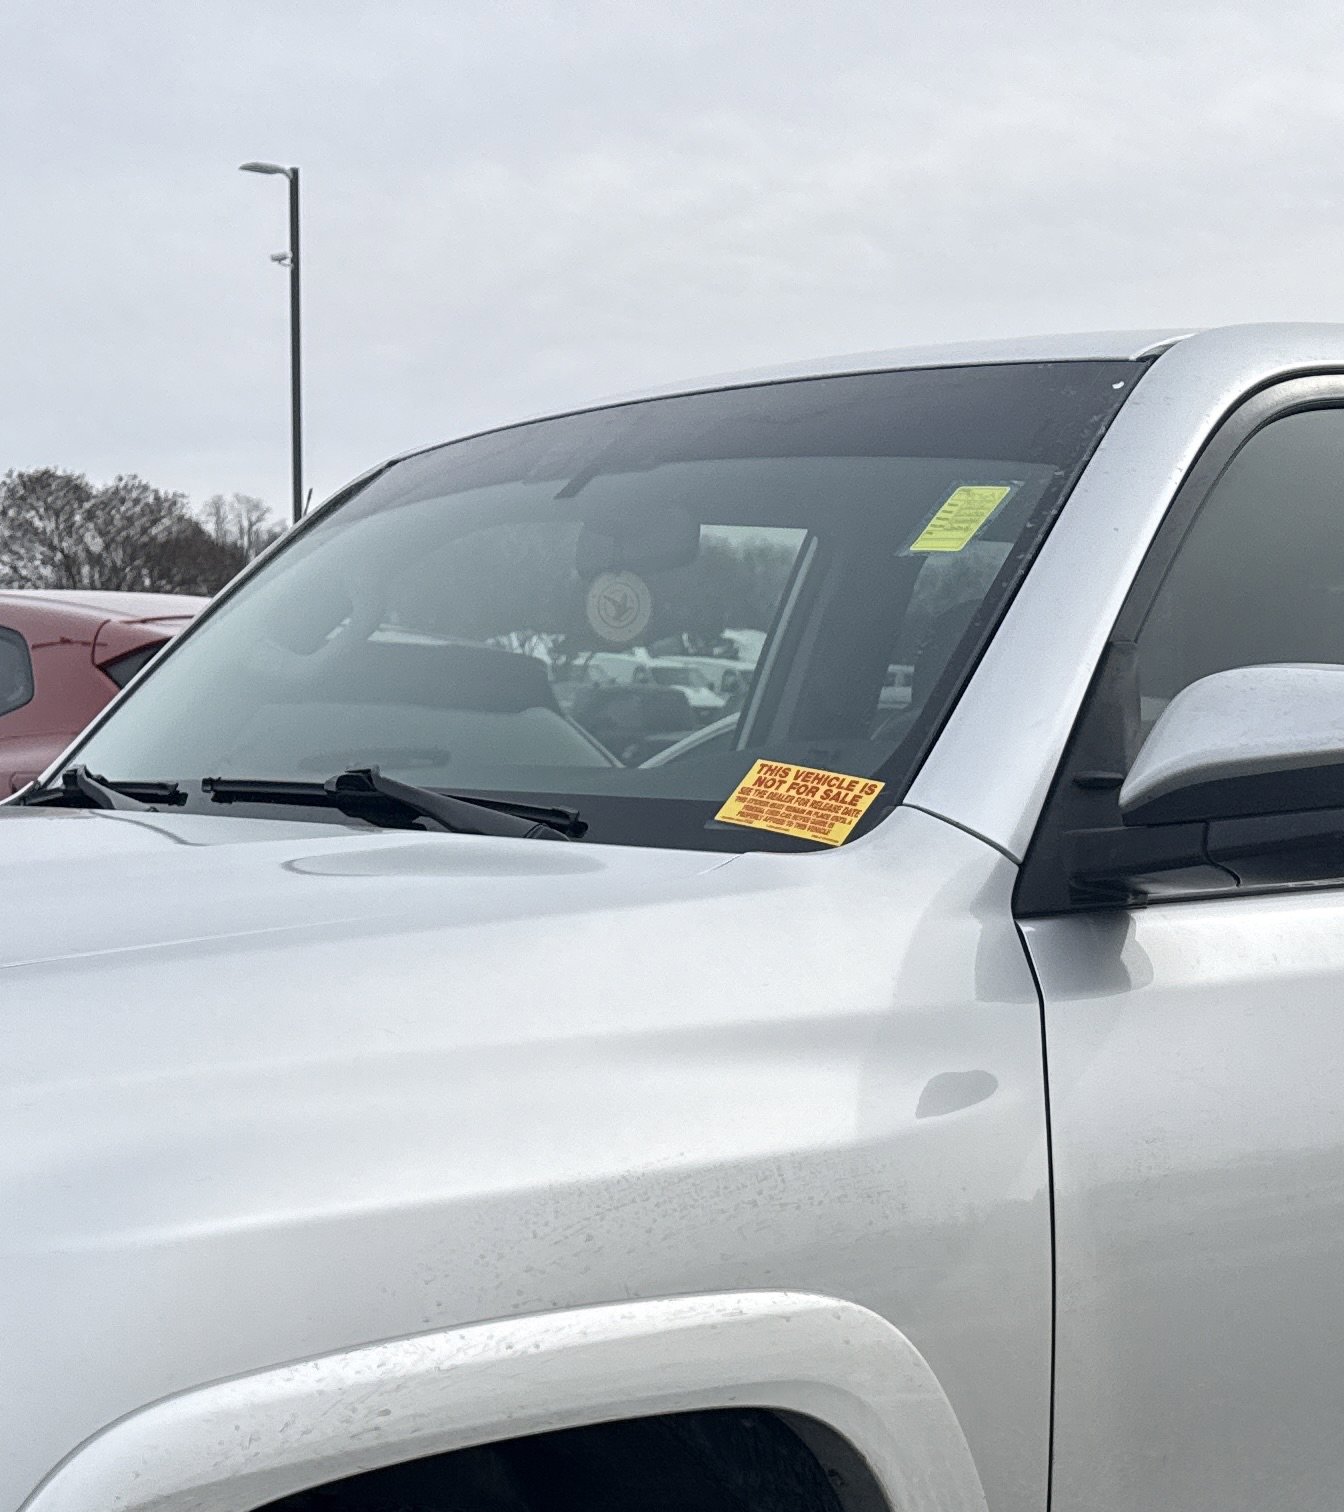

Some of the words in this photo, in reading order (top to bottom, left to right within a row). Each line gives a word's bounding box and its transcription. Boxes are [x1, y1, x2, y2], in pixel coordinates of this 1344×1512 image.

[752, 776, 787, 790] NOT
[786, 782, 820, 797] FOR
[820, 789, 863, 806] SALE
[757, 763, 791, 778] THIS
[793, 770, 858, 792] VEHICLE
[860, 783, 878, 795] IS
[738, 787, 754, 795] SEE
[753, 789, 768, 798] THE
[766, 792, 795, 803] DEALER
[794, 797, 810, 807] FOR
[809, 800, 843, 813] RELEASE
[841, 807, 862, 817] DATE
